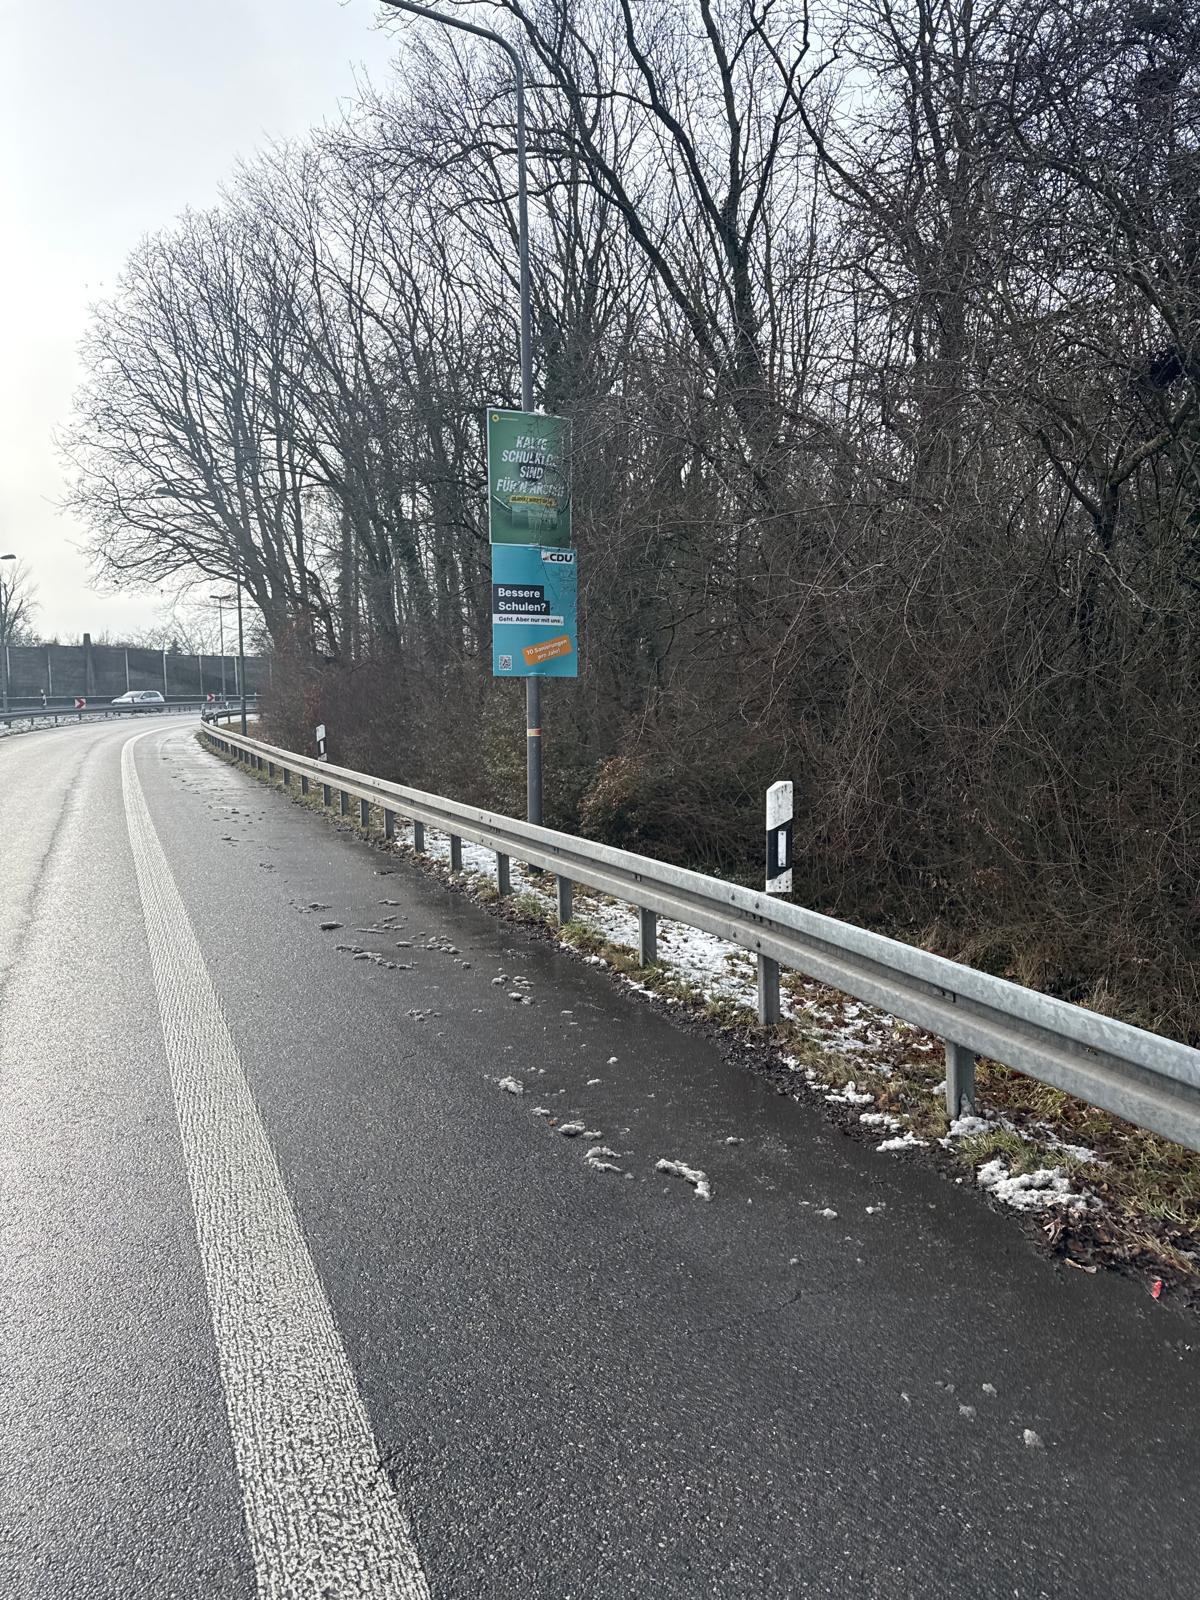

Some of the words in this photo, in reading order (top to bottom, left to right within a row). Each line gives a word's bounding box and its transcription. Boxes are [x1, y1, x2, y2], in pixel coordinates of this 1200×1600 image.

[516, 436, 548, 450] KALTE
[520, 466, 544, 479] SIND
[549, 553, 573, 562] CDU
[498, 588, 541, 598] Bessere
[498, 602, 546, 612] Schulen?
